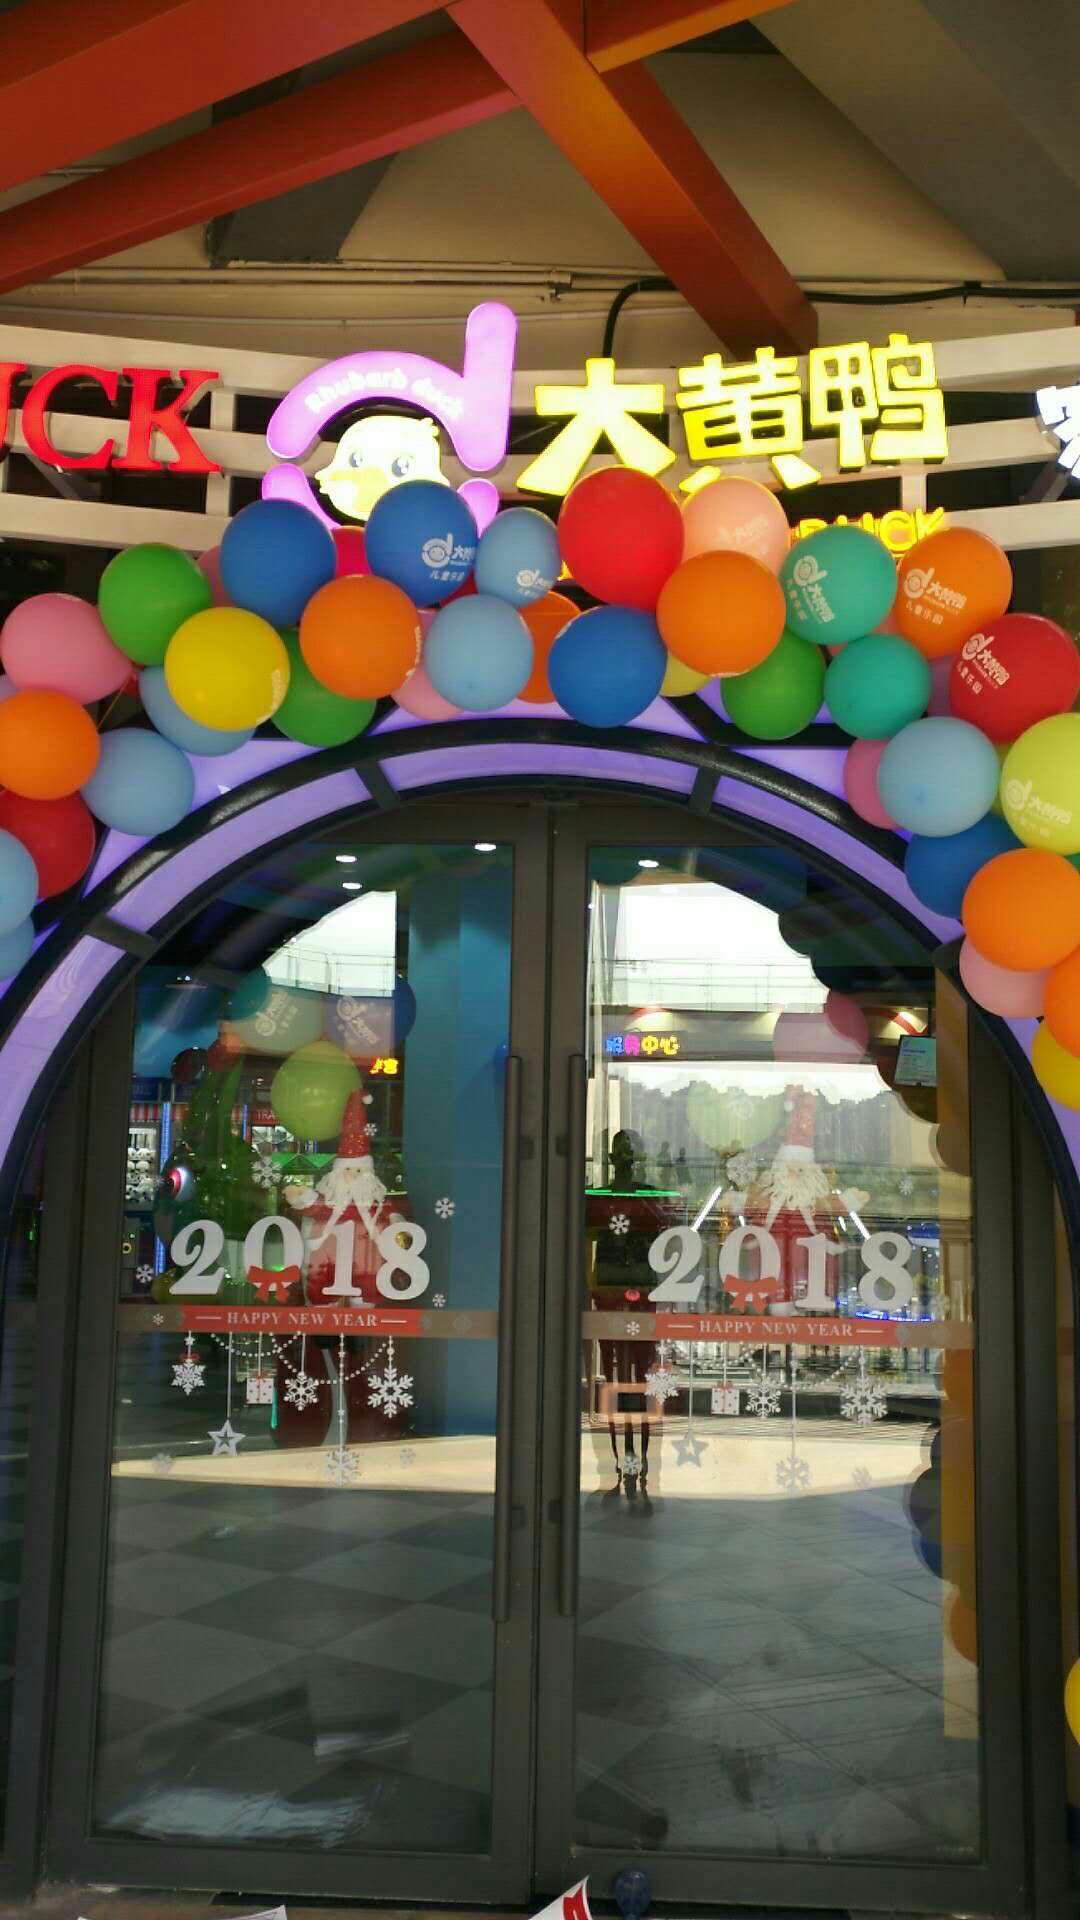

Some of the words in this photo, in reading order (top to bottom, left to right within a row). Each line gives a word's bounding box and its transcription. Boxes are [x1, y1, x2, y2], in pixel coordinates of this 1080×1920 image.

[0, 362, 222, 472] CK
[516, 333, 949, 496] 大黄鸭
[169, 1215, 431, 1300] 2018
[648, 1225, 914, 1310] 2018
[227, 1311, 281, 1326] HAPPY
[288, 1313, 327, 1326] NEW
[332, 1314, 378, 1327] YEAR
[700, 1319, 756, 1334] HAPPY
[762, 1321, 801, 1335] NEW
[807, 1323, 853, 1337] YEAR
